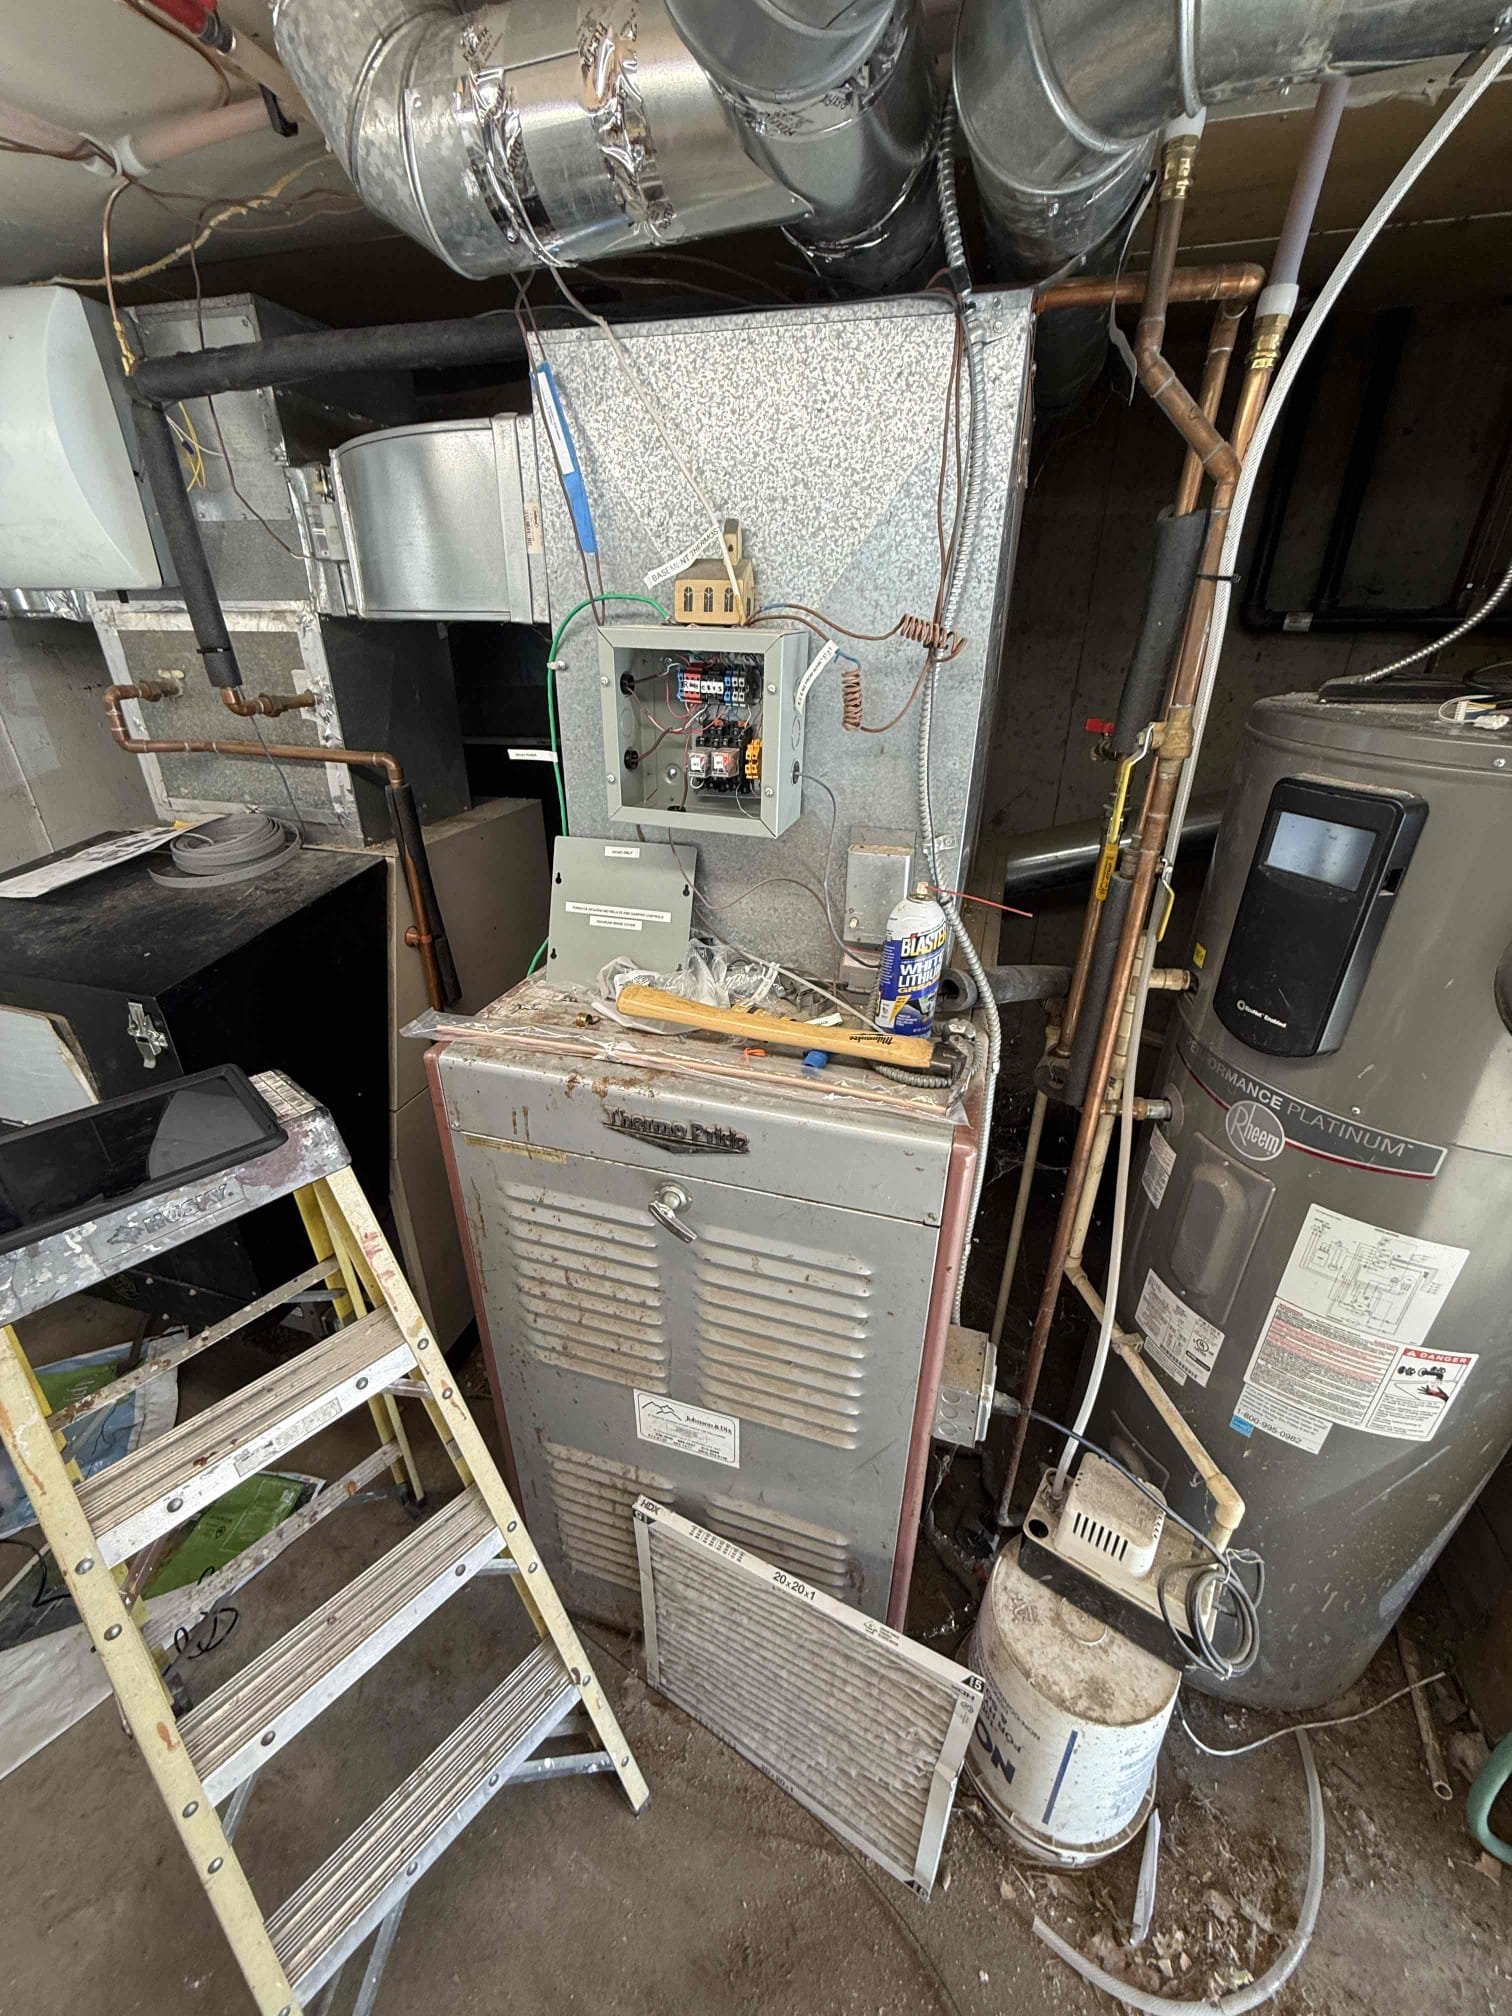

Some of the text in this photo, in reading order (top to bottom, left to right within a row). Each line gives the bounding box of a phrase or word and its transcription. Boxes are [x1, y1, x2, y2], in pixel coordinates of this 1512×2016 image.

[690, 527, 718, 557] THERMOS
[603, 1104, 687, 1139] Thermo
[1230, 1104, 1279, 1154] Rheem
[143, 1183, 227, 1233] HUSKY
[1420, 1352, 1468, 1364] DANGER
[1236, 1408, 1302, 1445] 1-800-995-0982
[640, 1499, 661, 1515] HDX
